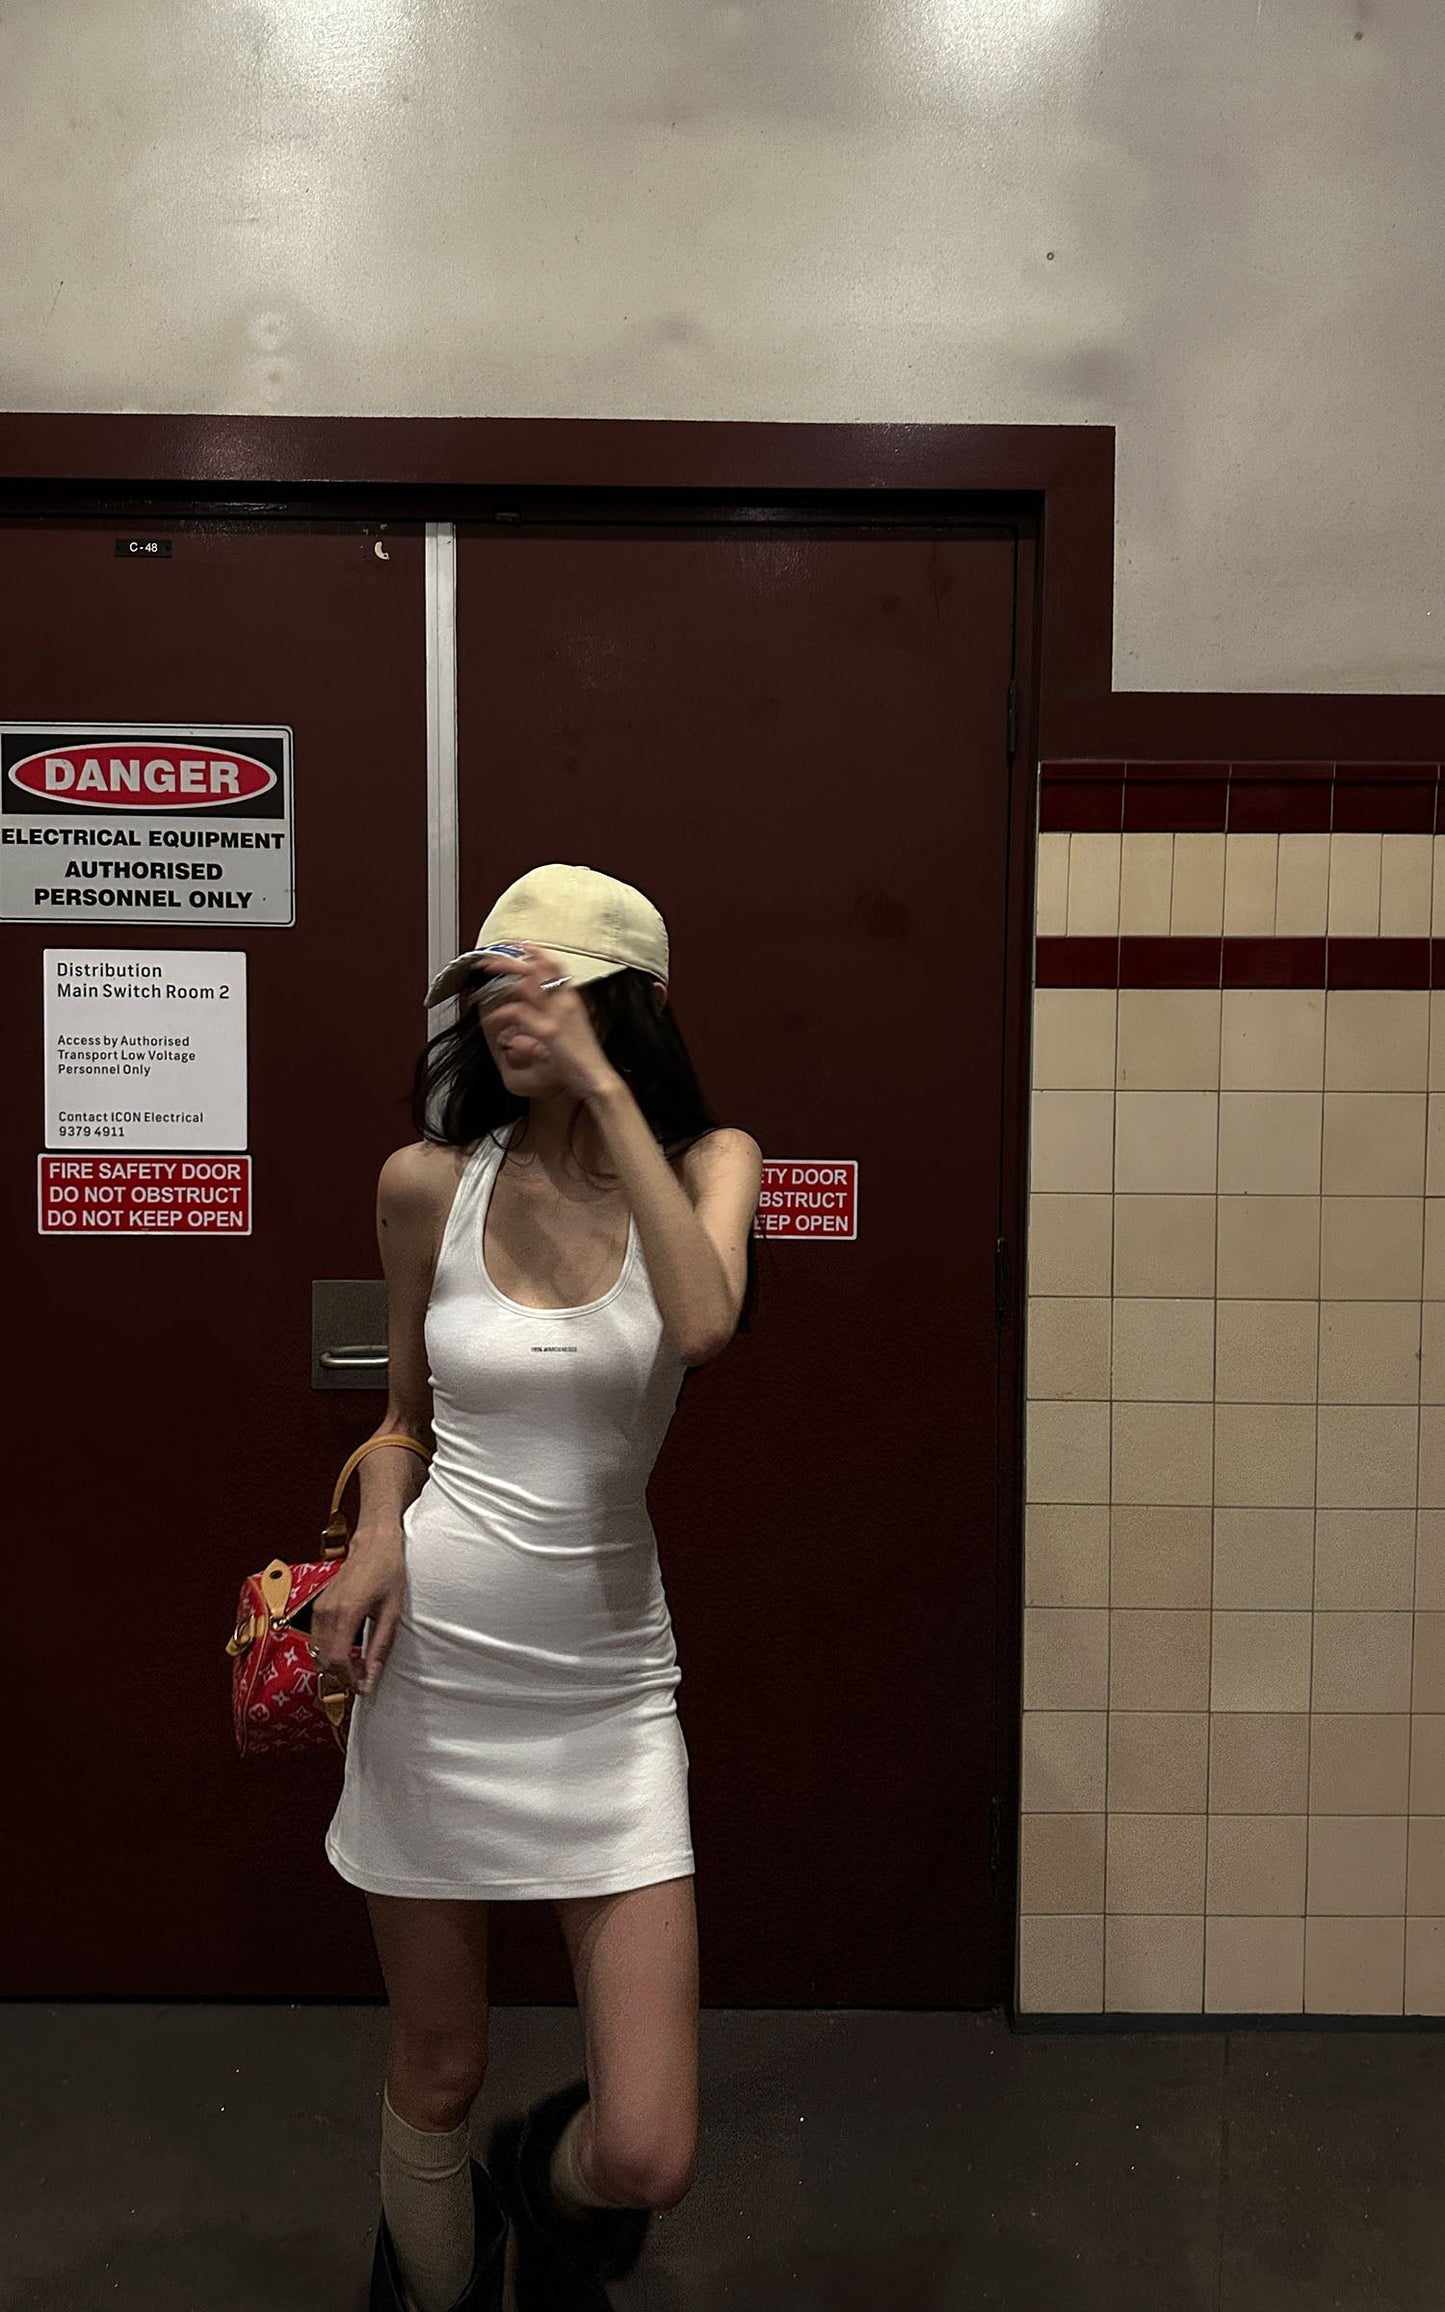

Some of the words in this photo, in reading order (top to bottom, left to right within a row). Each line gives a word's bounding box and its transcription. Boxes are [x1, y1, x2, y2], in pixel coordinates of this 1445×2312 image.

[129, 542, 158, 552] C-48
[45, 758, 240, 794] DANGER
[2, 828, 141, 847] ELECTRICAL
[149, 831, 285, 849] EQUIPMENT
[65, 861, 223, 880] AUTHORISED
[34, 888, 181, 908] PERSONNEL
[189, 891, 253, 909] ONLY
[57, 962, 162, 977] Distribution
[57, 984, 98, 998] Main
[103, 984, 160, 999] Switch
[166, 985, 214, 999] Room
[219, 986, 229, 999] 2
[58, 1036, 101, 1045] Access
[104, 1035, 118, 1048] by
[121, 1036, 189, 1047] Authorised
[58, 1050, 118, 1061] Transport
[122, 1050, 145, 1060] Low
[148, 1050, 195, 1063] Voltage
[58, 1065, 120, 1075] Personnel
[123, 1065, 150, 1076] Only
[59, 1112, 107, 1122] Contact
[111, 1112, 141, 1122] ICON
[144, 1112, 203, 1123] Electrical
[59, 1126, 91, 1136] 9379
[94, 1127, 125, 1137] 4911
[49, 1163, 93, 1179] FIRE
[99, 1164, 177, 1180] SAFETY
[182, 1164, 241, 1180] DOOR
[792, 1169, 847, 1185] DOOR
[50, 1187, 78, 1202] DO
[85, 1187, 126, 1203] NOT
[131, 1187, 241, 1203] OBSTRUCT
[759, 1192, 847, 1208] BSTRUCT
[48, 1210, 76, 1226] DO
[83, 1211, 124, 1226] NOT
[129, 1211, 183, 1226] KEEP
[188, 1211, 242, 1227] OPEN
[796, 1216, 848, 1231] OPEN
